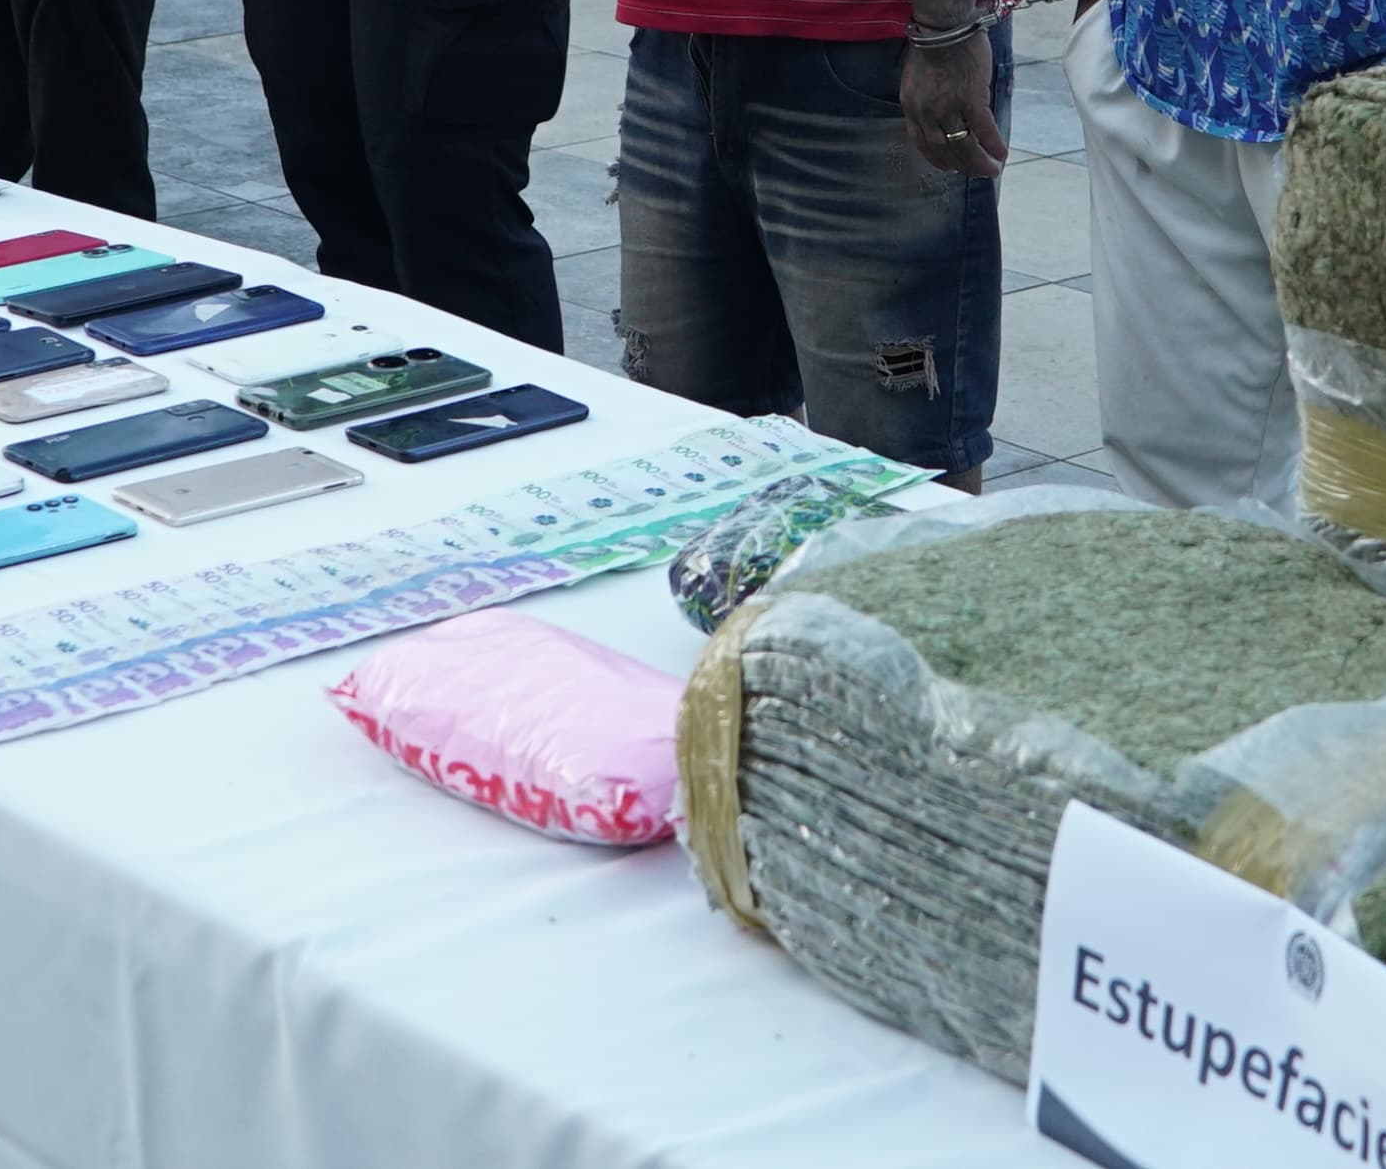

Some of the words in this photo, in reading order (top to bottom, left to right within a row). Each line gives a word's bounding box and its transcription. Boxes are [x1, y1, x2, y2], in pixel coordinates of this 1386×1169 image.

[632, 458, 660, 473] 100
[580, 470, 608, 484] 100
[523, 484, 551, 501] 100
